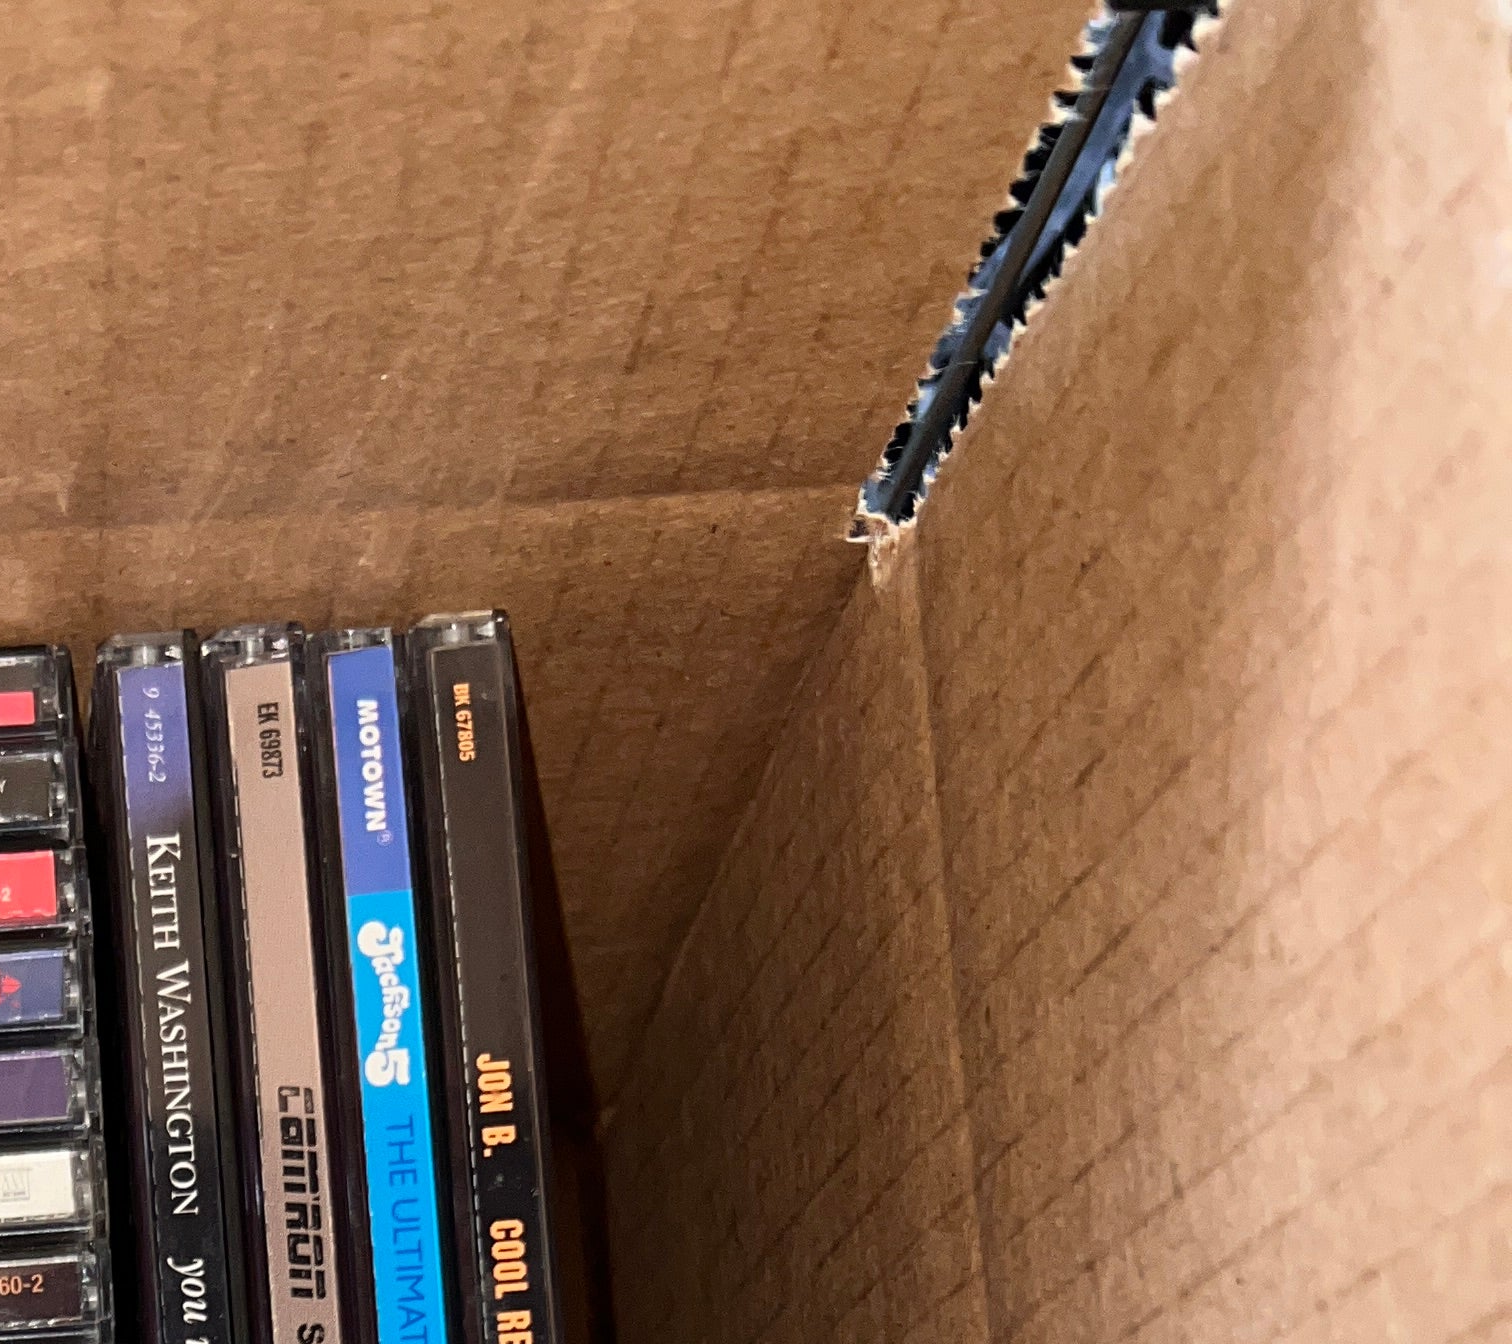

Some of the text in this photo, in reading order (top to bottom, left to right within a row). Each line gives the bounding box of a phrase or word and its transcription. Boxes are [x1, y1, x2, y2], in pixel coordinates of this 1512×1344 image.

[260, 730, 283, 779] 69873
[476, 1053, 514, 1113] JON
[385, 1116, 418, 1186] THE
[168, 1258, 206, 1324] you
[489, 1219, 528, 1299] COOL
